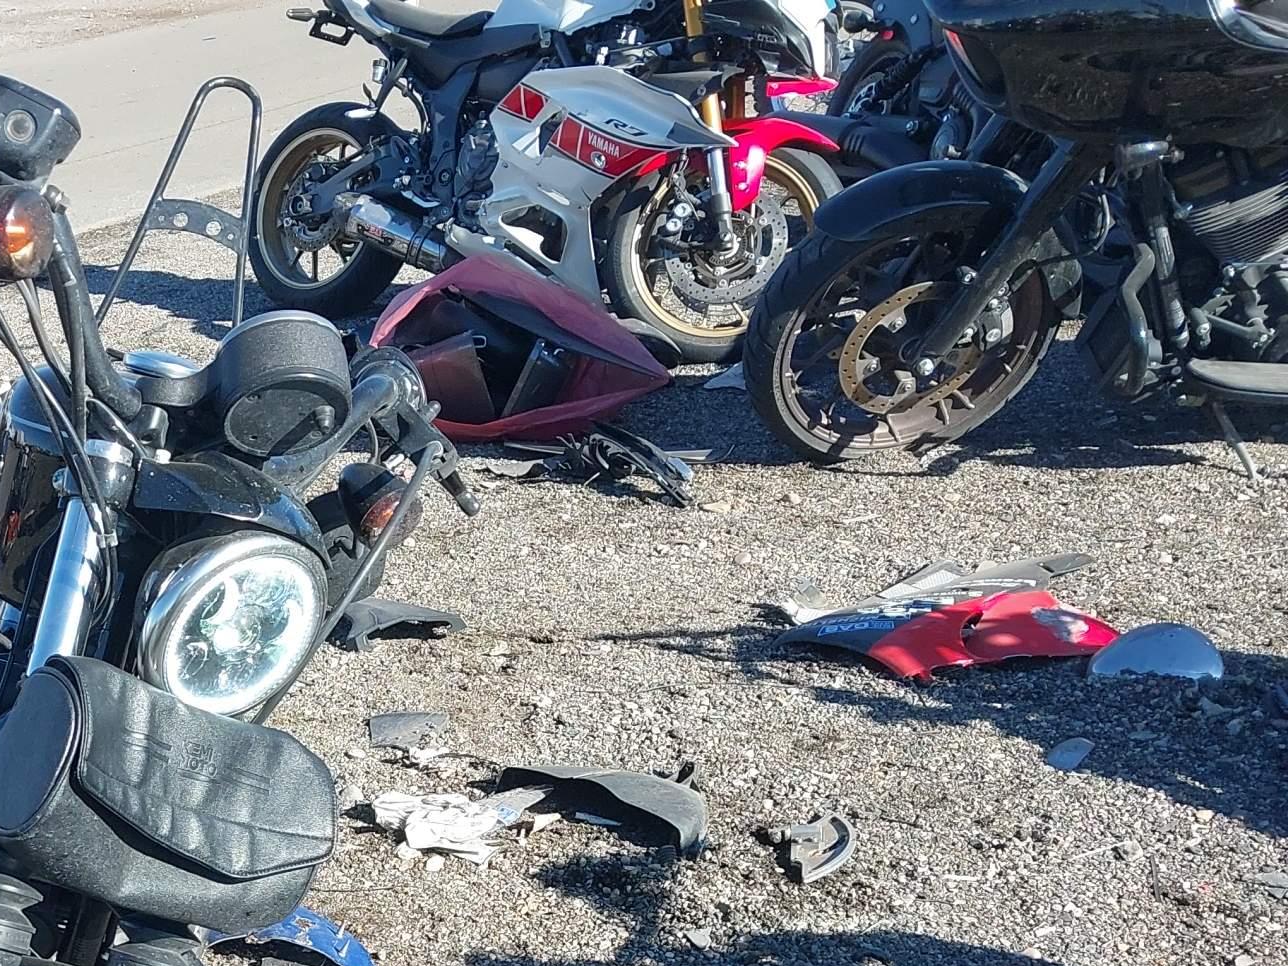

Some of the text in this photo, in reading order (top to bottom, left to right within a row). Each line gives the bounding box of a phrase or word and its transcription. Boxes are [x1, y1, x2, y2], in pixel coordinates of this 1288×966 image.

[603, 118, 649, 137] R7
[587, 131, 620, 158] YAMAHA
[182, 740, 214, 763] KEMI
[178, 754, 218, 778] MOTO
